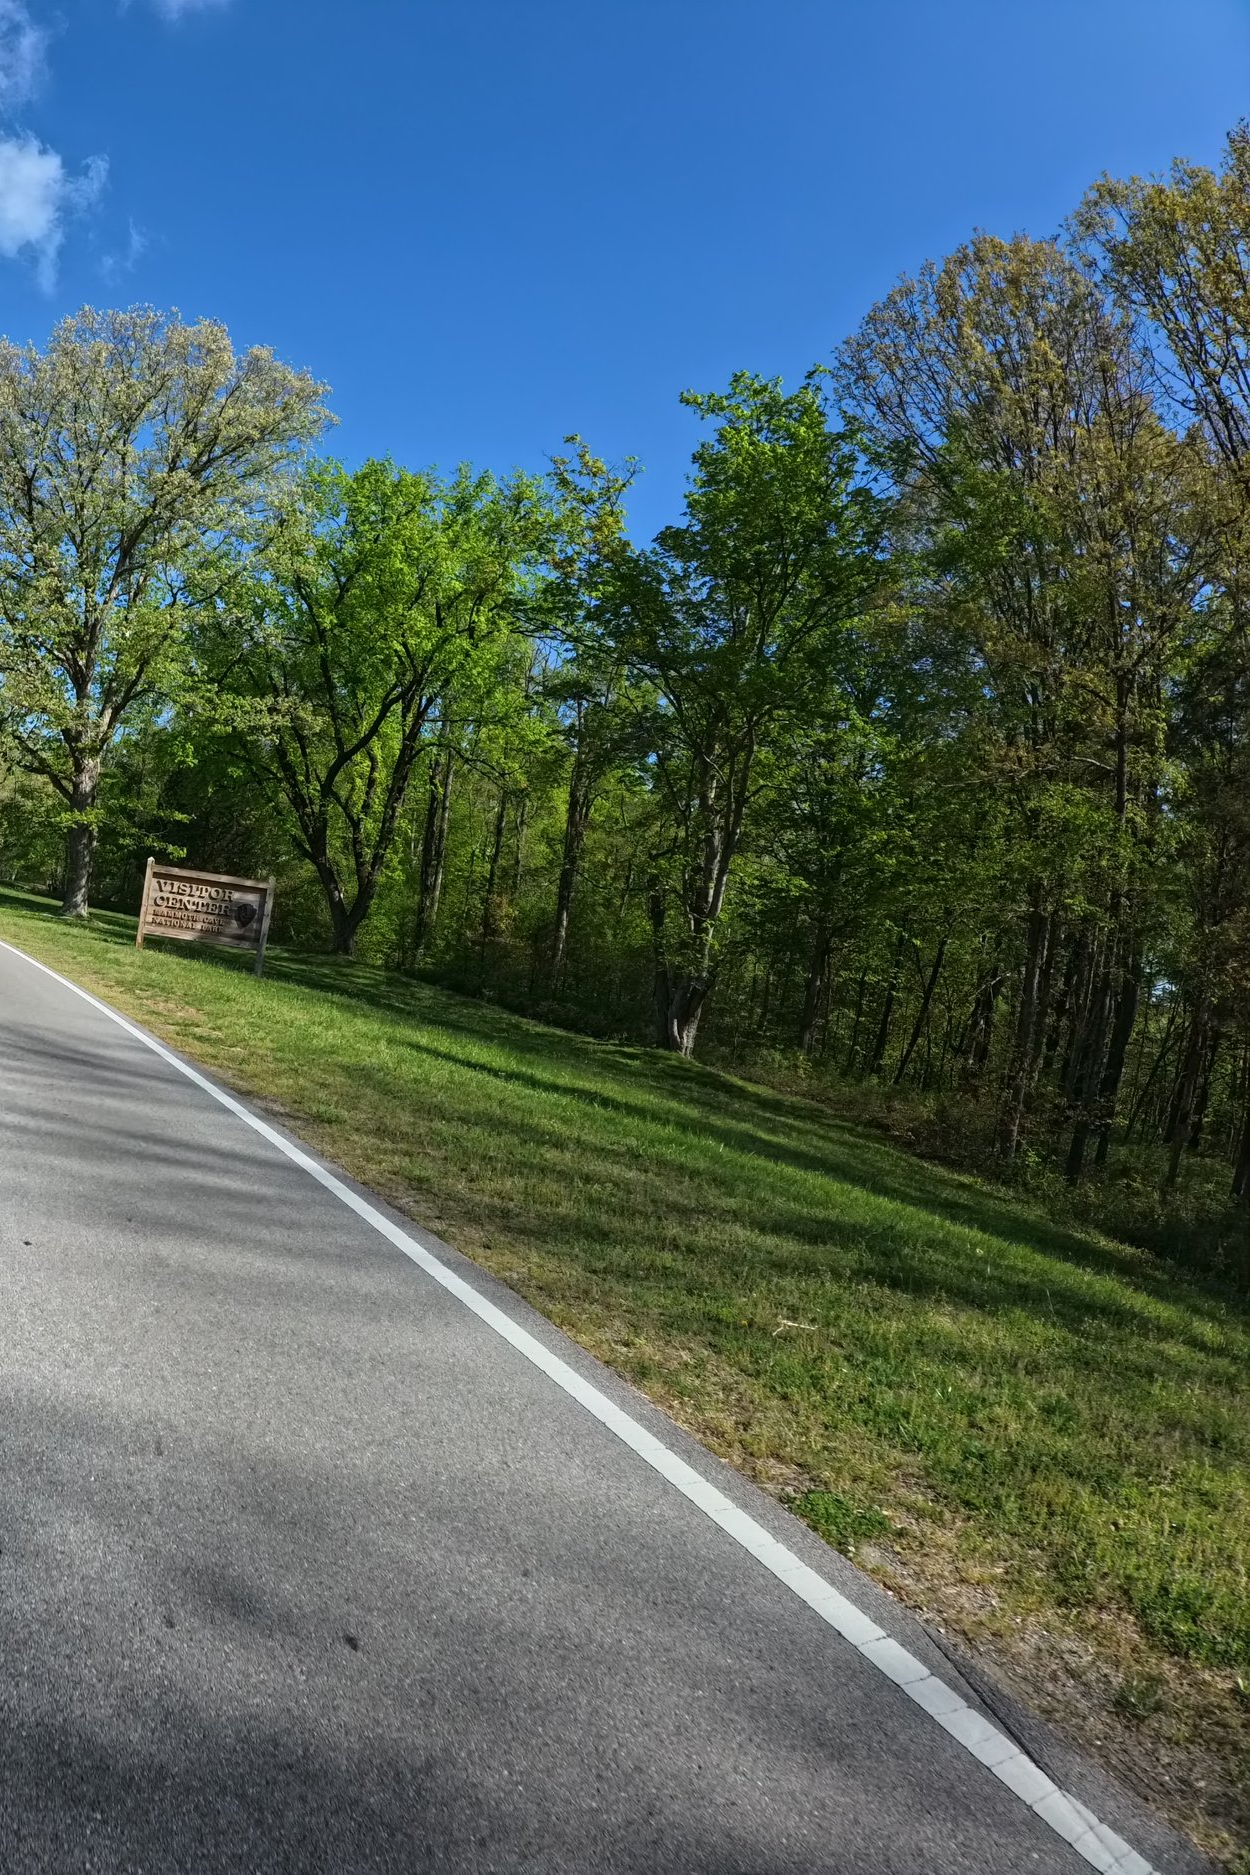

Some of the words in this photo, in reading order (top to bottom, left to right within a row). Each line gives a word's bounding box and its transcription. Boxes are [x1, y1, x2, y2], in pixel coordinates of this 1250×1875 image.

[156, 880, 235, 902] VISITOR
[153, 895, 231, 916] CENTER
[151, 917, 197, 930] NATIONAL
[152, 909, 199, 922] MAMMOTH
[202, 916, 225, 926] CAVE
